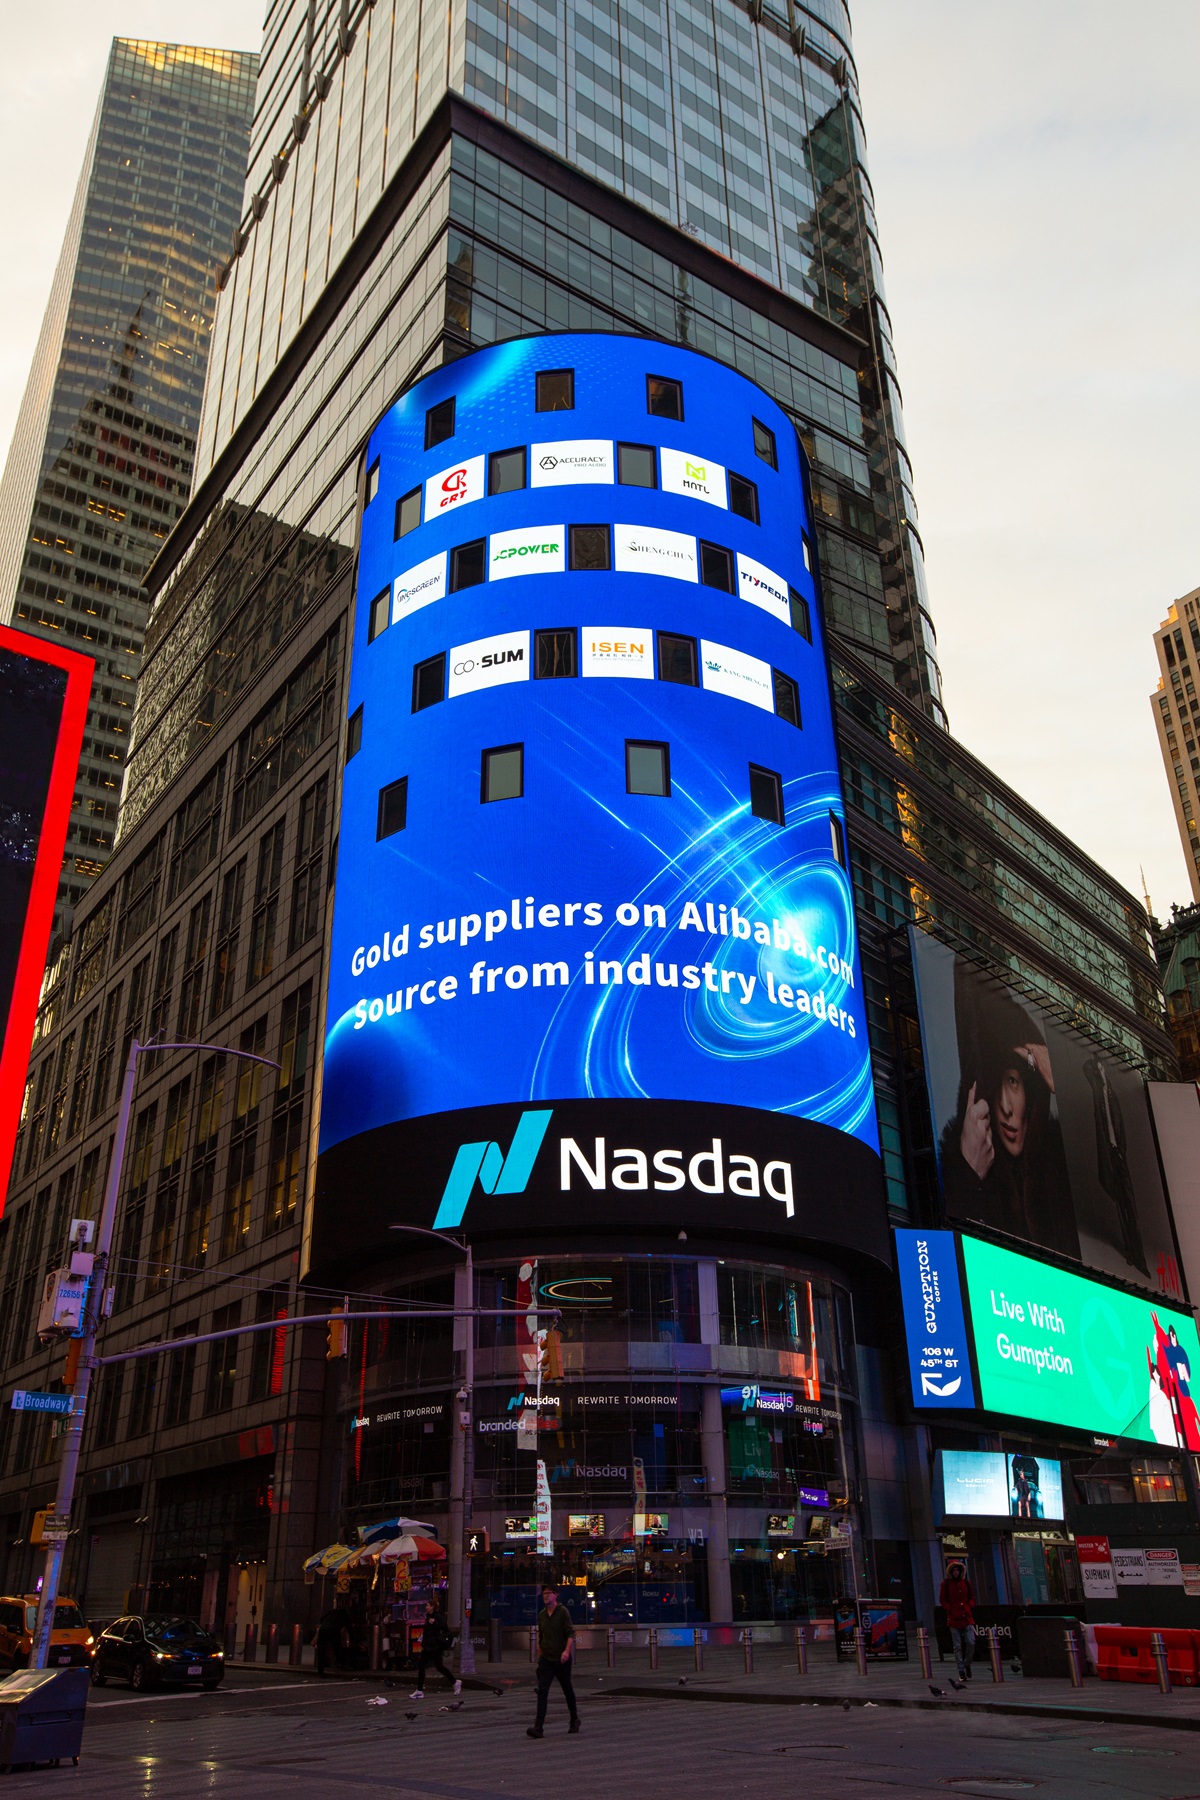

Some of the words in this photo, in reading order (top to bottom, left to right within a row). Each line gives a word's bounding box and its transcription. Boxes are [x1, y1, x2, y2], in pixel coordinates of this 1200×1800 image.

[558, 456, 604, 464] ACCURACY
[440, 489, 467, 507] GRT
[493, 543, 560, 561] JCPOWER
[592, 642, 644, 654] ISEN
[351, 926, 409, 977] Gold
[418, 897, 602, 949] suppliers
[616, 901, 667, 927] on
[680, 901, 855, 989] Alibaba.com
[353, 974, 457, 1030] Source
[469, 961, 570, 995] from
[584, 951, 756, 1005] industry
[767, 970, 856, 1039] leaders
[559, 1137, 794, 1218] Nasdaq
[917, 1240, 937, 1333] GUMPTION
[932, 1271, 941, 1302] COFFEE
[60, 1289, 81, 1299] 726156
[990, 1290, 1025, 1323] Live
[1027, 1301, 1066, 1335] With
[922, 1347, 941, 1356] 106
[943, 1347, 954, 1356] W
[996, 1333, 1074, 1375] Gumption
[920, 1358, 942, 1367] 45TH
[944, 1359, 959, 1368] ST
[25, 1394, 67, 1412] Broadway
[524, 1395, 560, 1406] Nasdaq
[577, 1396, 619, 1405] REWRITE
[624, 1396, 678, 1405] TOMORROW
[756, 1400, 784, 1412] Nasdaq
[376, 1411, 400, 1423] REWRITE
[403, 1405, 443, 1418] TOMORROW
[795, 1404, 819, 1415] REWRITE
[479, 1418, 526, 1432] branded
[576, 1464, 627, 1480] Nasdaq
[755, 1467, 780, 1480] Nasdaq
[1114, 1556, 1144, 1567] PEDESTRIANS
[1149, 1551, 1173, 1559] DANGER
[1085, 1569, 1110, 1580] SUBWAY
